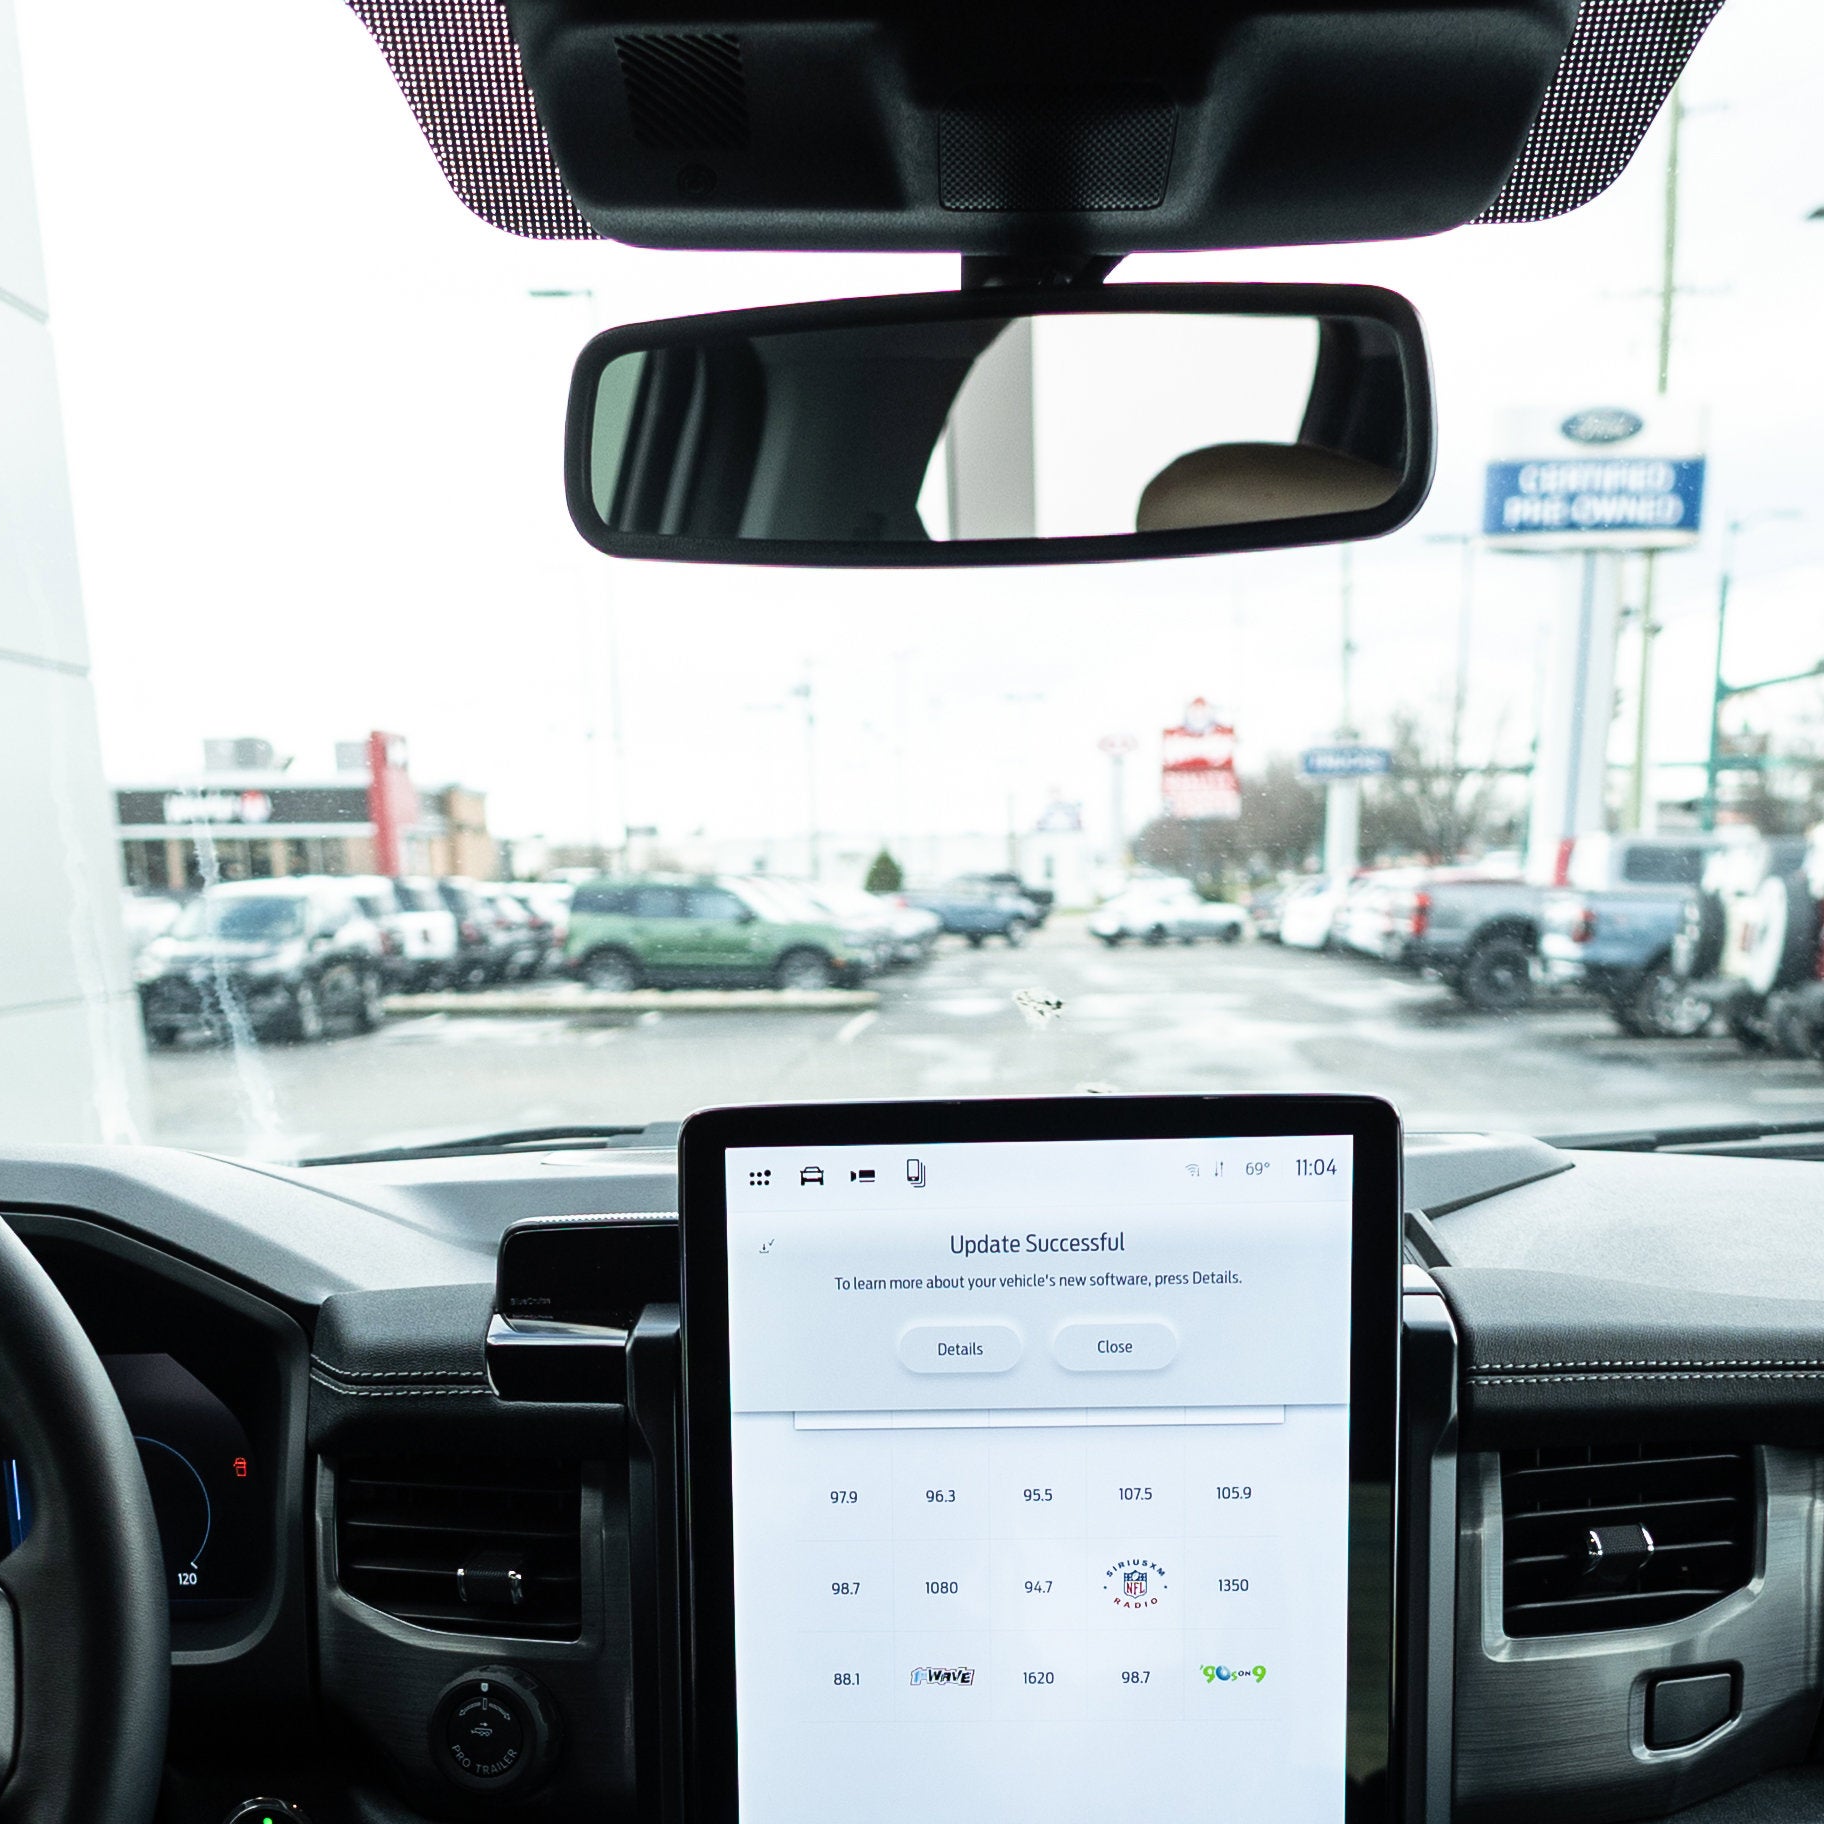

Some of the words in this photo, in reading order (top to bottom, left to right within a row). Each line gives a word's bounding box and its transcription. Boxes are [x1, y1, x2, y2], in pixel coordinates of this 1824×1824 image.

[1296, 1159, 1336, 1176] 11:04
[951, 1234, 1020, 1257] Update
[1026, 1232, 1124, 1252] Successful
[835, 1277, 850, 1290] To
[852, 1277, 886, 1290] learn
[890, 1279, 922, 1289] more
[927, 1275, 964, 1288] about
[968, 1278, 996, 1290] your
[998, 1274, 1055, 1287] vehicle's
[1060, 1277, 1086, 1286] new
[1090, 1272, 1151, 1290] software,
[1155, 1275, 1189, 1287] press
[1193, 1270, 1241, 1284] Details.
[938, 1342, 983, 1356] Details
[1098, 1340, 1132, 1353] Close
[831, 1491, 857, 1503] 97.9
[926, 1490, 955, 1502] 96.3
[1024, 1489, 1052, 1505] 95.5
[1119, 1488, 1152, 1500] 107.5
[1217, 1487, 1251, 1499] 105.9
[1107, 1560, 1165, 1577] SIRIUSXM
[178, 1571, 197, 1585] 120
[832, 1582, 860, 1595] 98.7
[926, 1582, 958, 1594] 1080
[1025, 1581, 1052, 1593] 94.7
[1126, 1581, 1145, 1595] NFL
[1219, 1579, 1248, 1591] 1350
[1114, 1598, 1157, 1608] RADIO
[834, 1673, 859, 1685] 88.1
[1024, 1672, 1054, 1684] 1620
[1122, 1671, 1150, 1683] 98.7
[1252, 1666, 1266, 1683] 9
[452, 1745, 470, 1767] PRO
[476, 1749, 517, 1775] TRAILER
